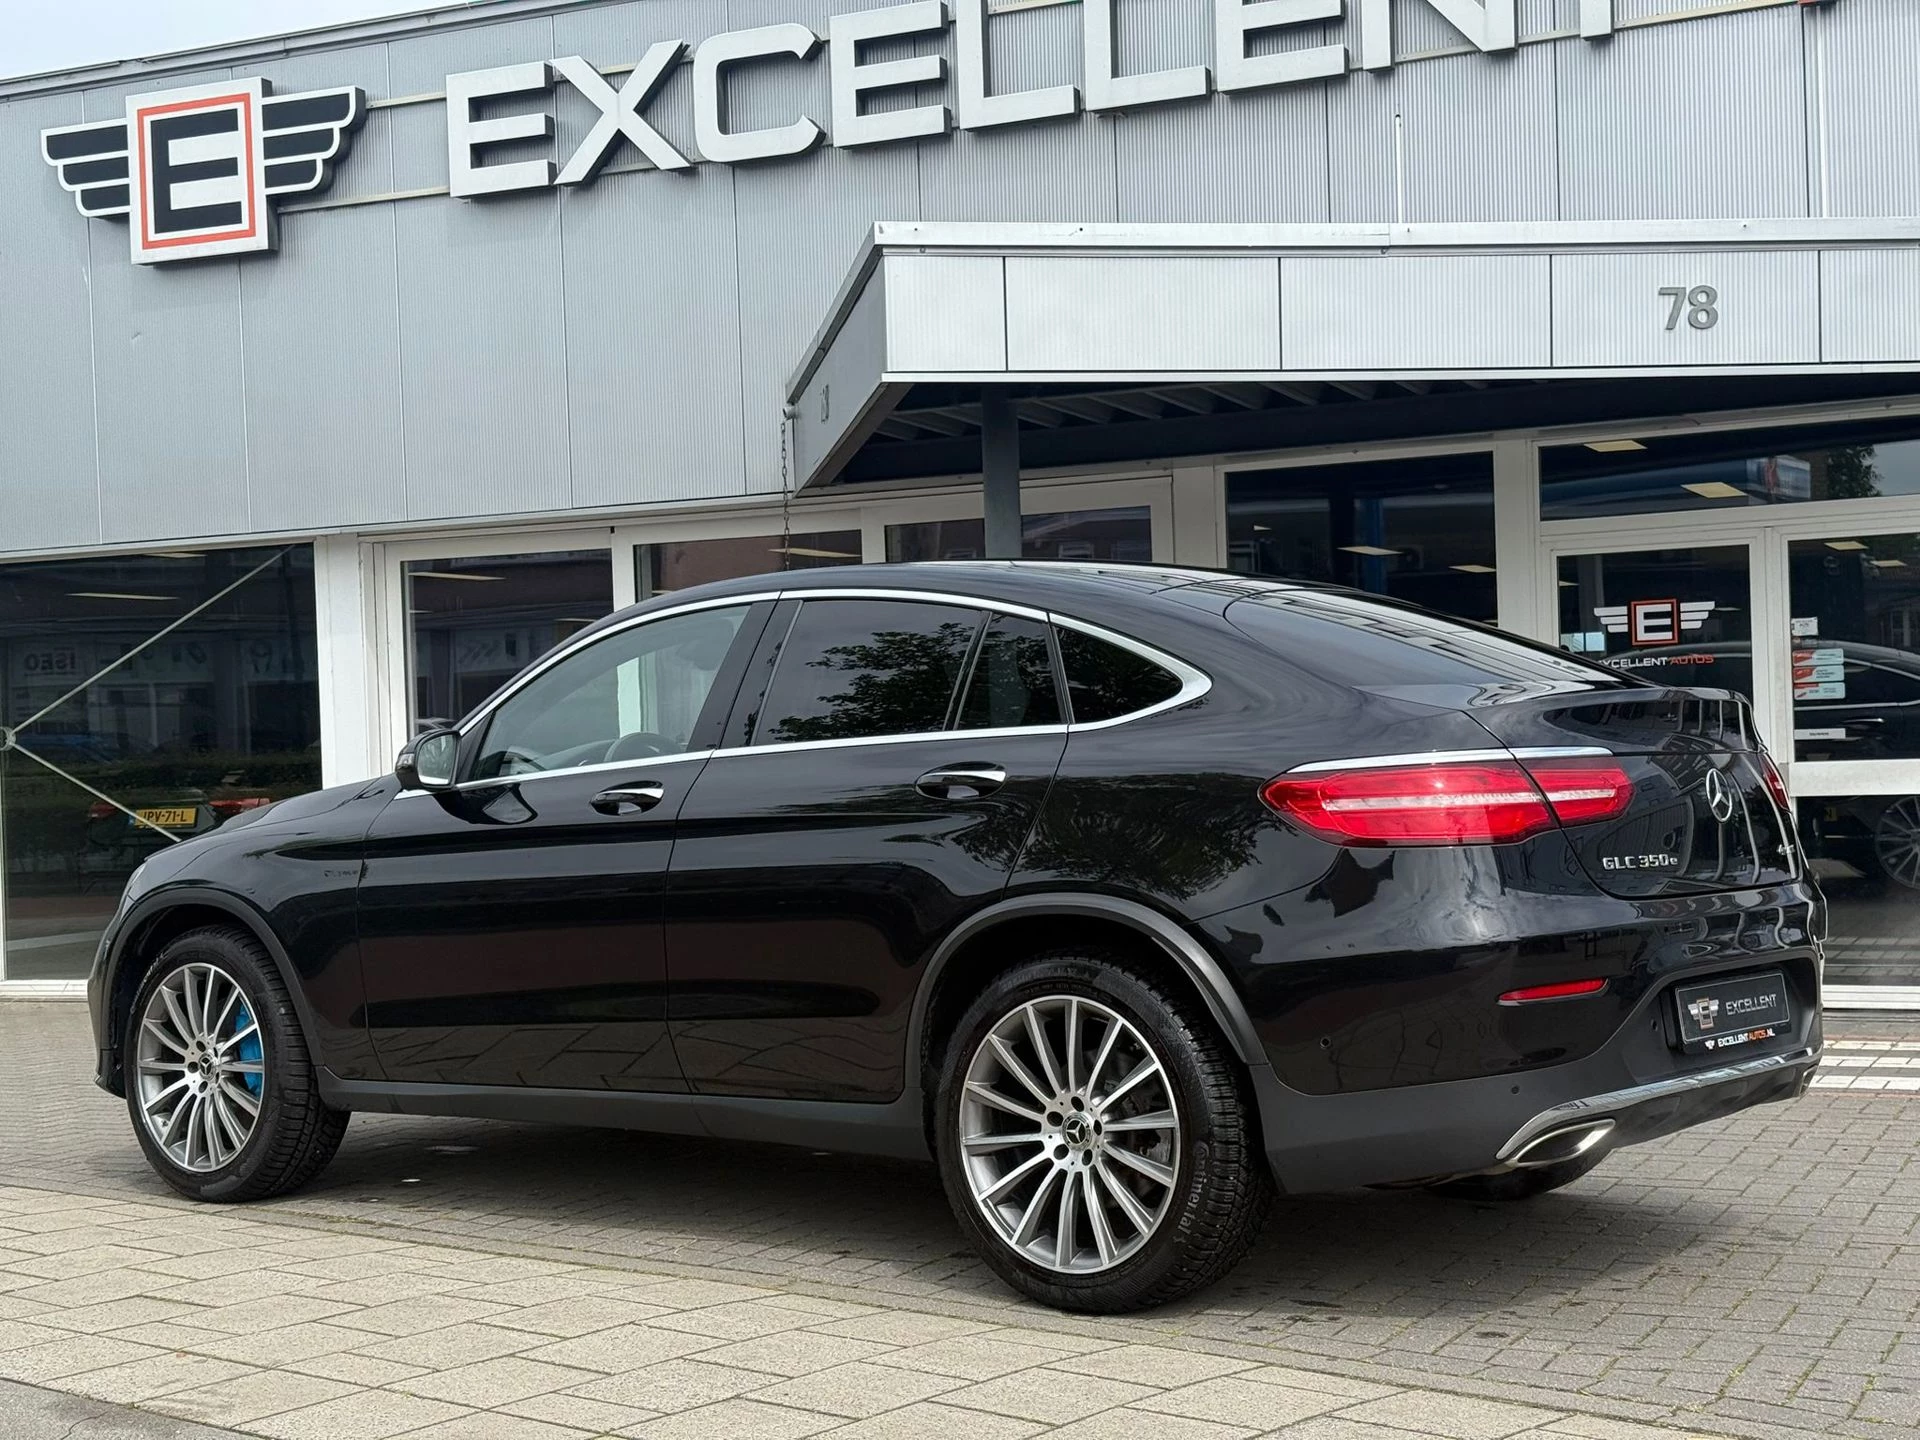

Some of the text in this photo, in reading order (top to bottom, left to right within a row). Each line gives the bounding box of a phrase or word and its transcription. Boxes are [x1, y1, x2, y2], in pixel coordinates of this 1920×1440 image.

[446, 0, 1613, 199] EXCELLE
[151, 108, 239, 235] E
[1658, 285, 1718, 330] 78
[1635, 603, 1672, 640] E
[1602, 853, 1678, 870] GLC 350e
[1725, 993, 1777, 1016] EXCELLENT
